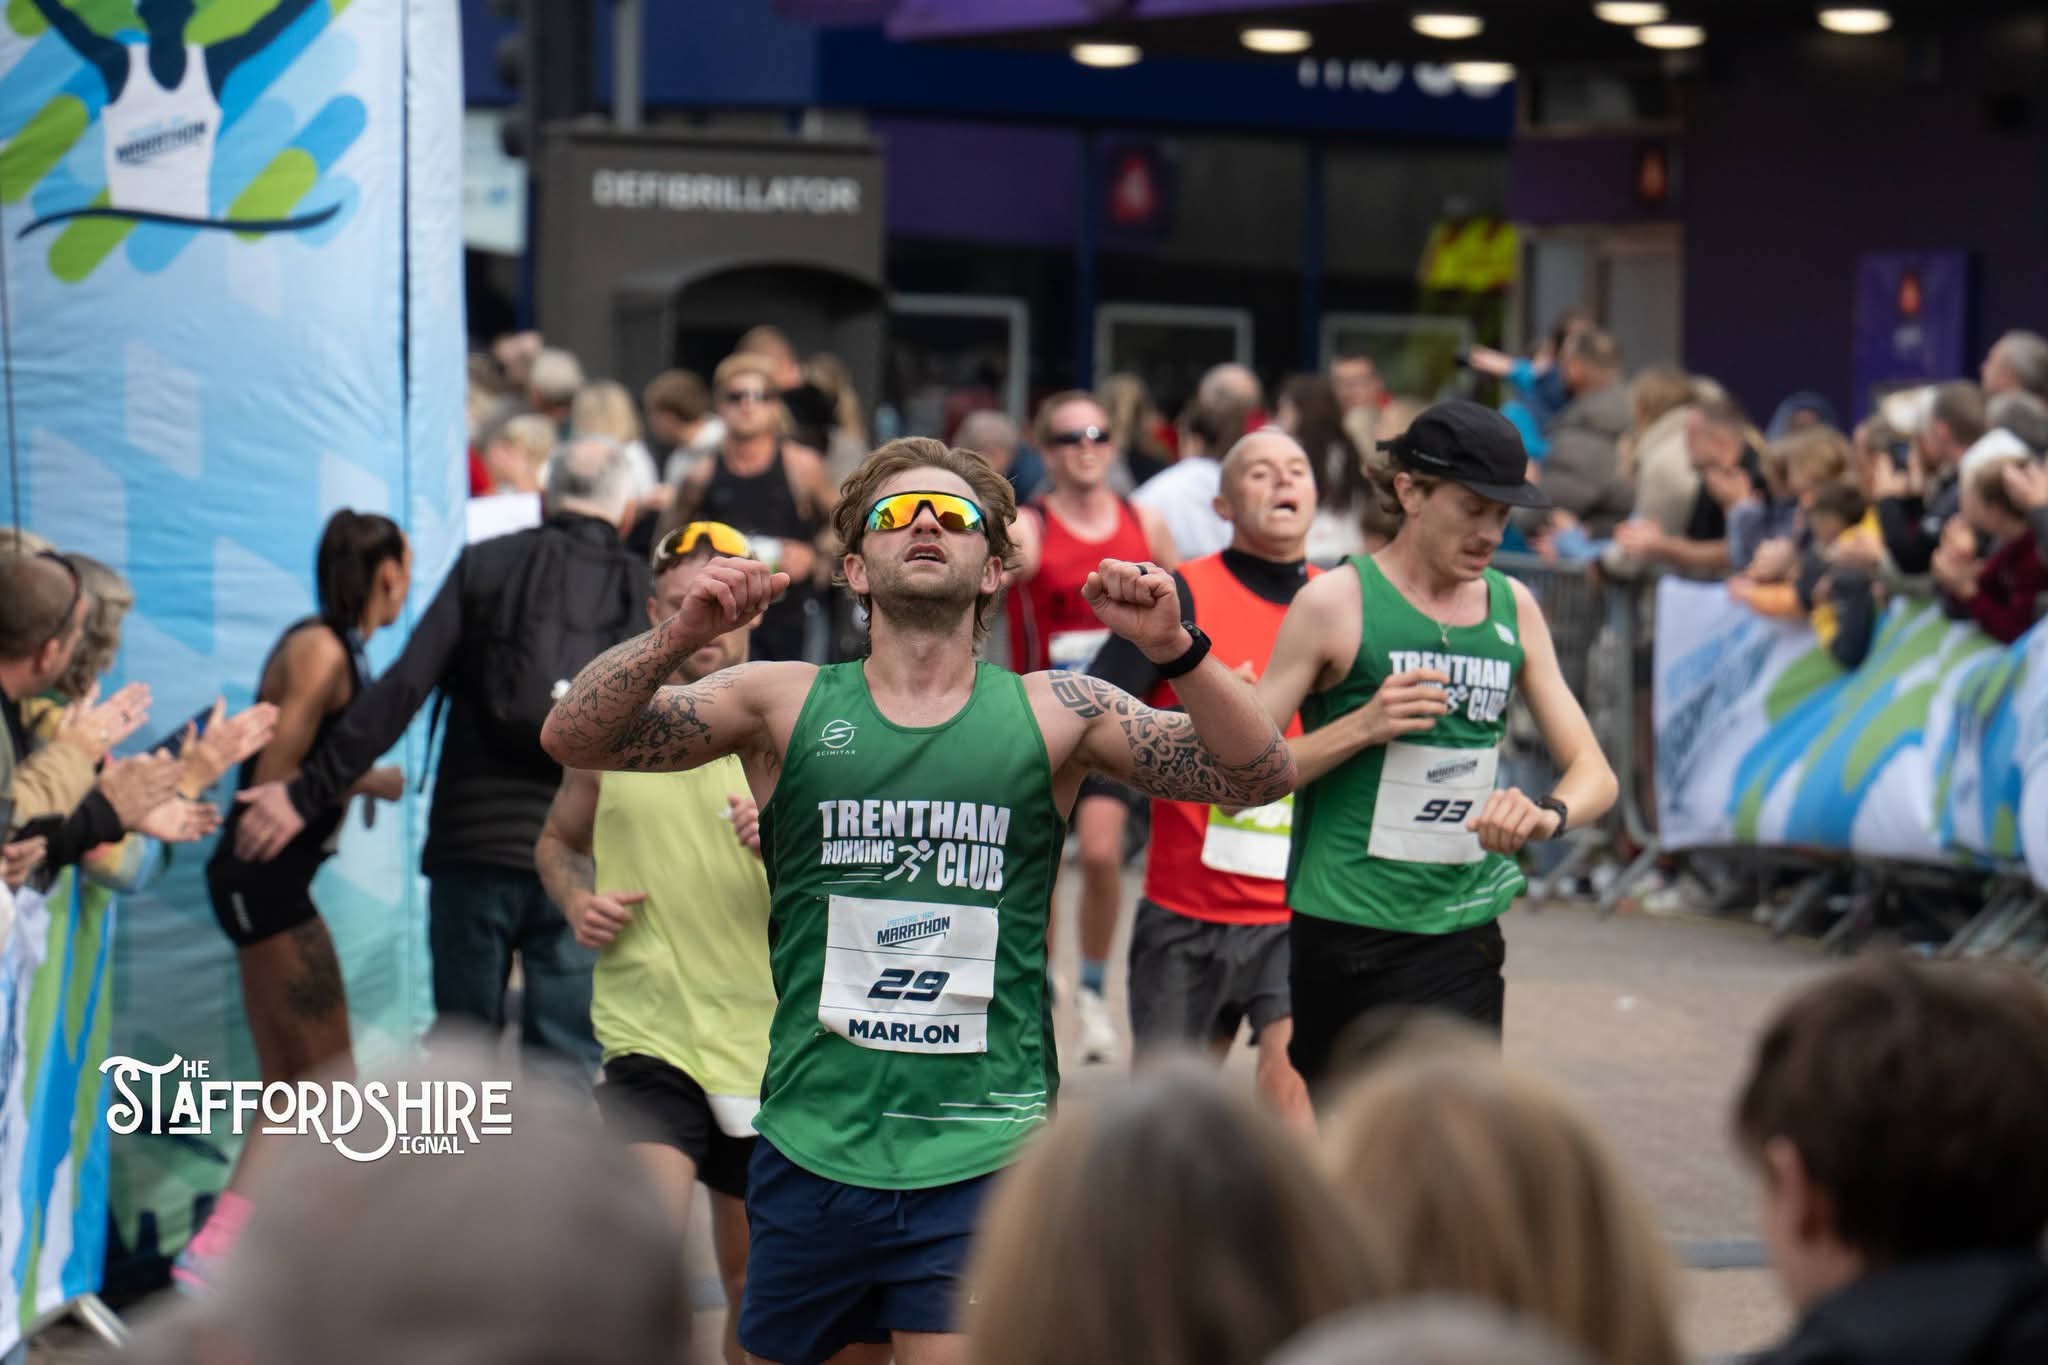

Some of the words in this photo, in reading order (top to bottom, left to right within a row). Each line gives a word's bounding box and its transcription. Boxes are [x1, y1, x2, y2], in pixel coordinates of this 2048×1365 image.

[592, 168, 862, 215] DEFIBRILLATOR
[818, 799, 1011, 846] TRENTHAM
[1414, 800, 1473, 823] 93
[821, 840, 895, 865] RUNNING
[936, 842, 1004, 892] CLUB
[877, 916, 950, 945] MARATHON
[867, 968, 950, 1002] 29
[848, 1018, 960, 1044] MARLON
